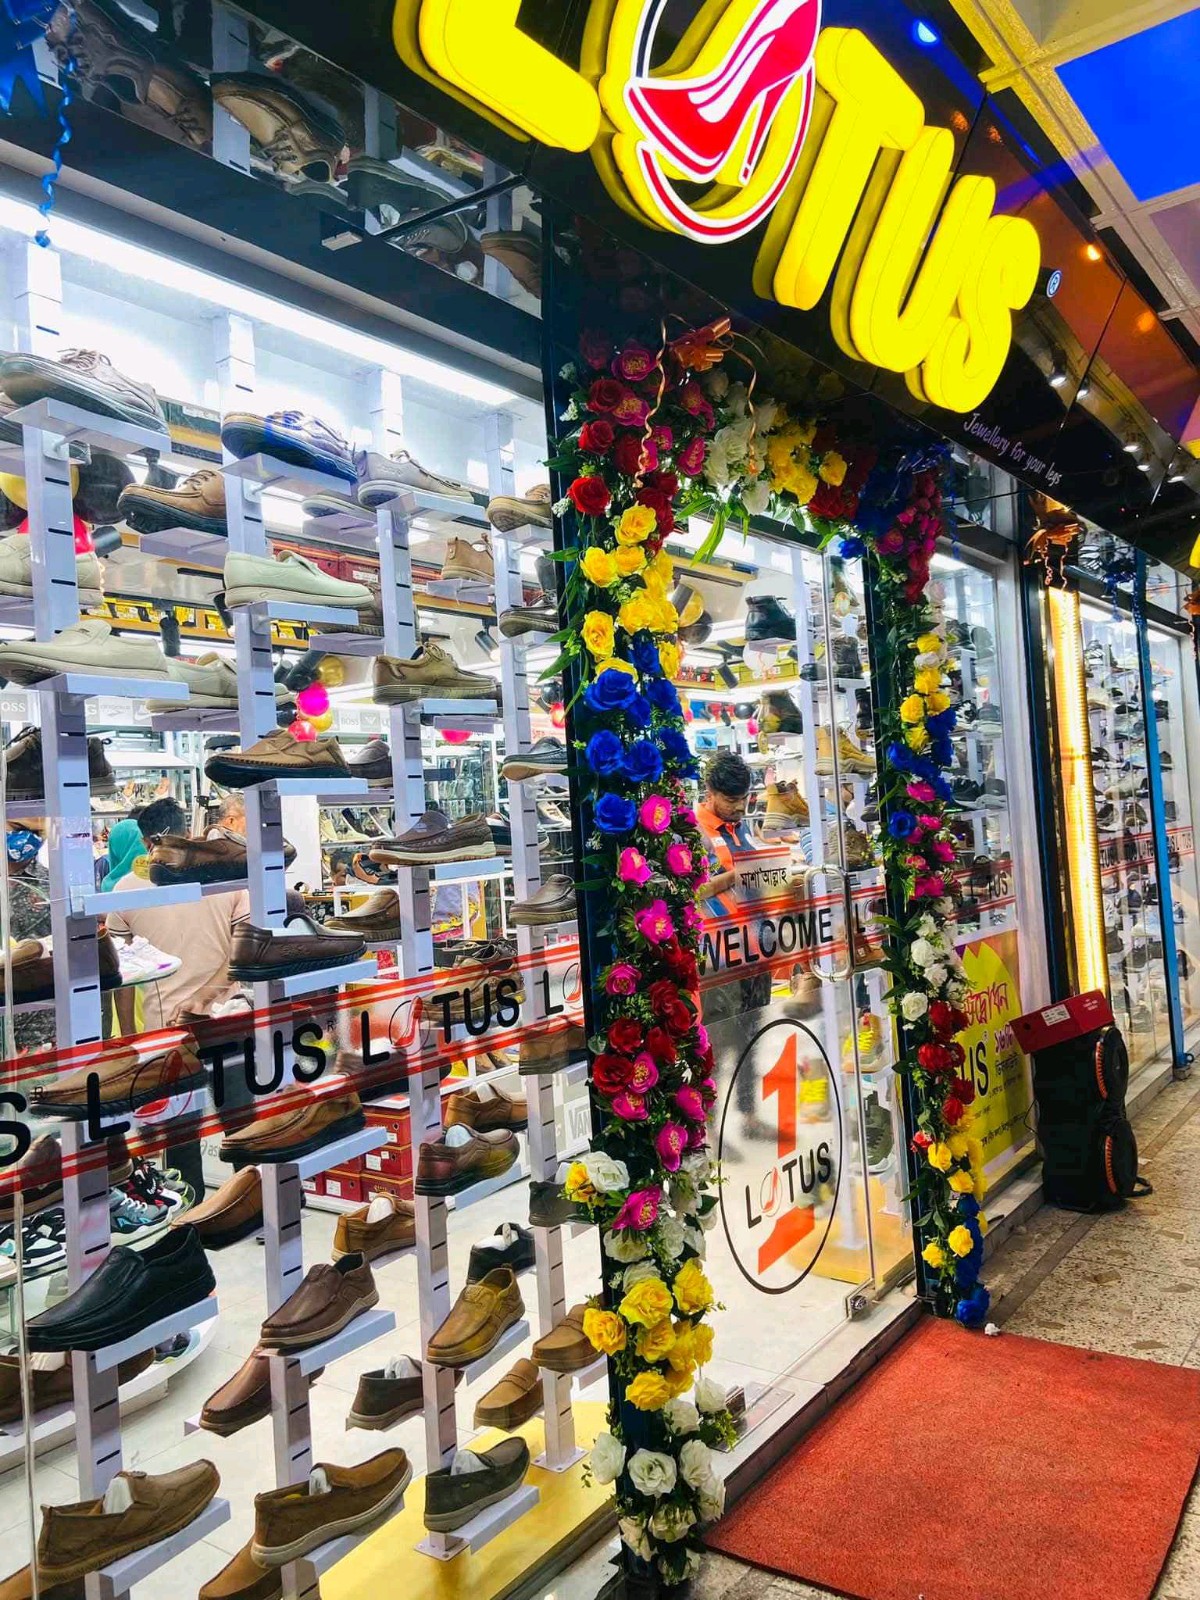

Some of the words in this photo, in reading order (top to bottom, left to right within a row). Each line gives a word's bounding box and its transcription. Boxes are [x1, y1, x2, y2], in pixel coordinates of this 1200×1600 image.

[963, 412, 1010, 456] Jewellery
[1009, 441, 1026, 462] for
[1022, 454, 1046, 474] your
[1045, 461, 1063, 487] legs
[699, 907, 834, 976] WELCOME
